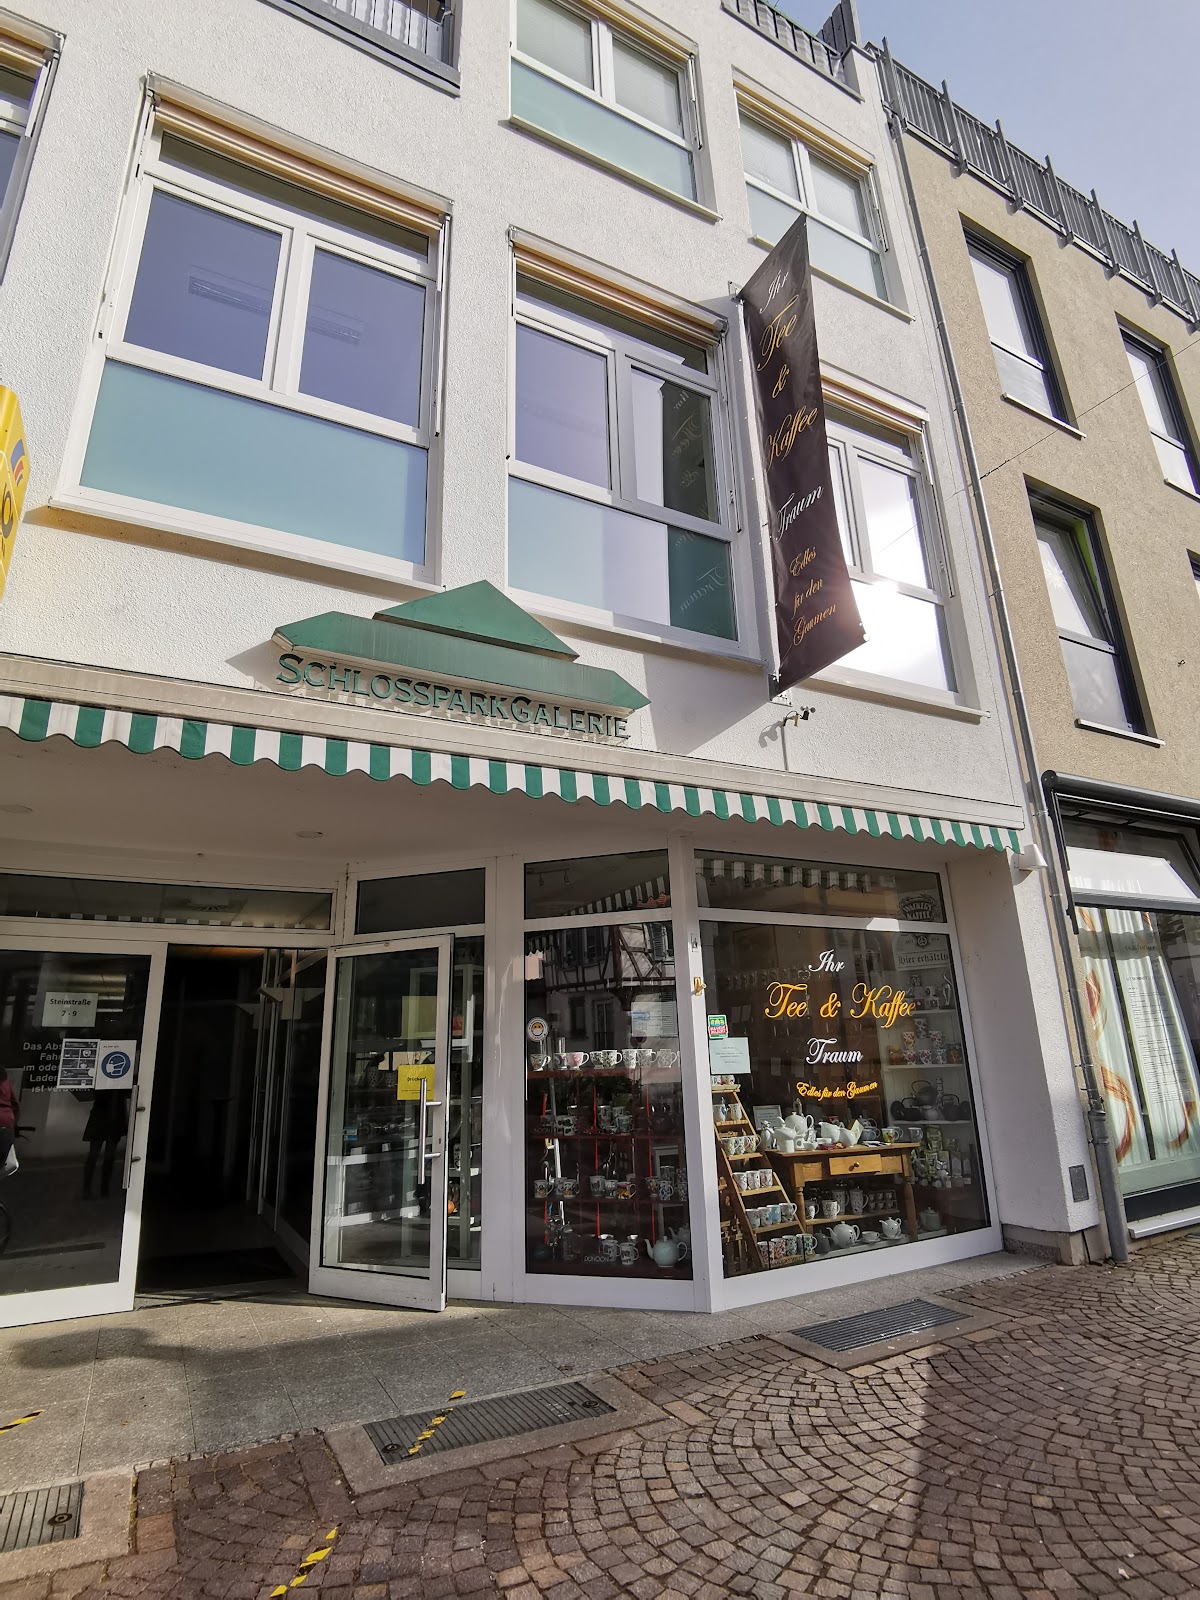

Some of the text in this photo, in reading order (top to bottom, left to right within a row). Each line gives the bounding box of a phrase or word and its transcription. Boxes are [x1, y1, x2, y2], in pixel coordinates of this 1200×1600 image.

[759, 269, 789, 310] Ihr
[757, 294, 800, 372] Tee
[772, 363, 790, 399] &
[764, 405, 818, 474] Kaffee
[776, 485, 825, 543] Traum
[789, 546, 817, 577] Edles
[805, 578, 823, 599] den
[793, 603, 836, 646] Gaumen
[808, 948, 845, 973] Ihr
[49, 998, 92, 1006] Steinstraße
[764, 981, 917, 1029] Tee & Kaffee
[23, 1042, 43, 1051] Das
[806, 1037, 863, 1065] Traum
[796, 1082, 821, 1098] Edles
[832, 1086, 846, 1098] den
[846, 1081, 878, 1099] Gaumen
